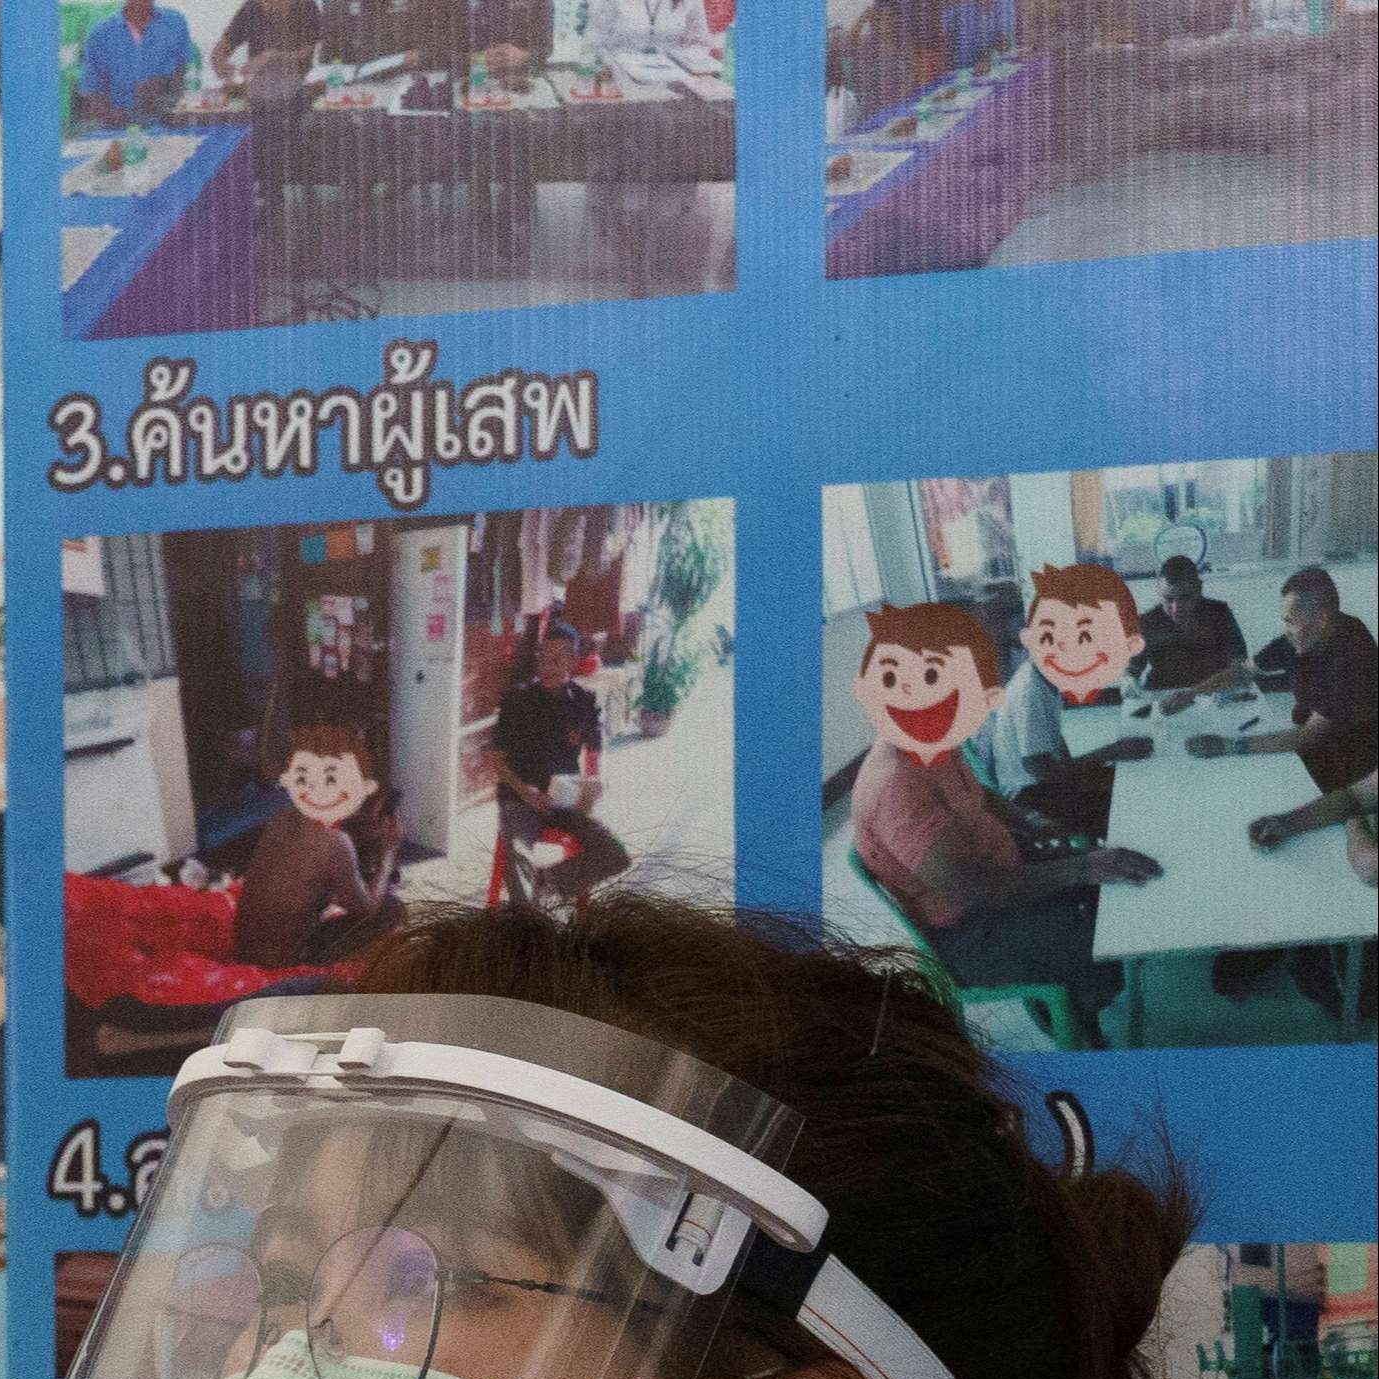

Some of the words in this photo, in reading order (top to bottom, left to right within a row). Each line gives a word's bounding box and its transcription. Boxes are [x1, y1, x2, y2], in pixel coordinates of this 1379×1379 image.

[50, 339, 599, 508] 3.ค้นหาผู้เสพ
